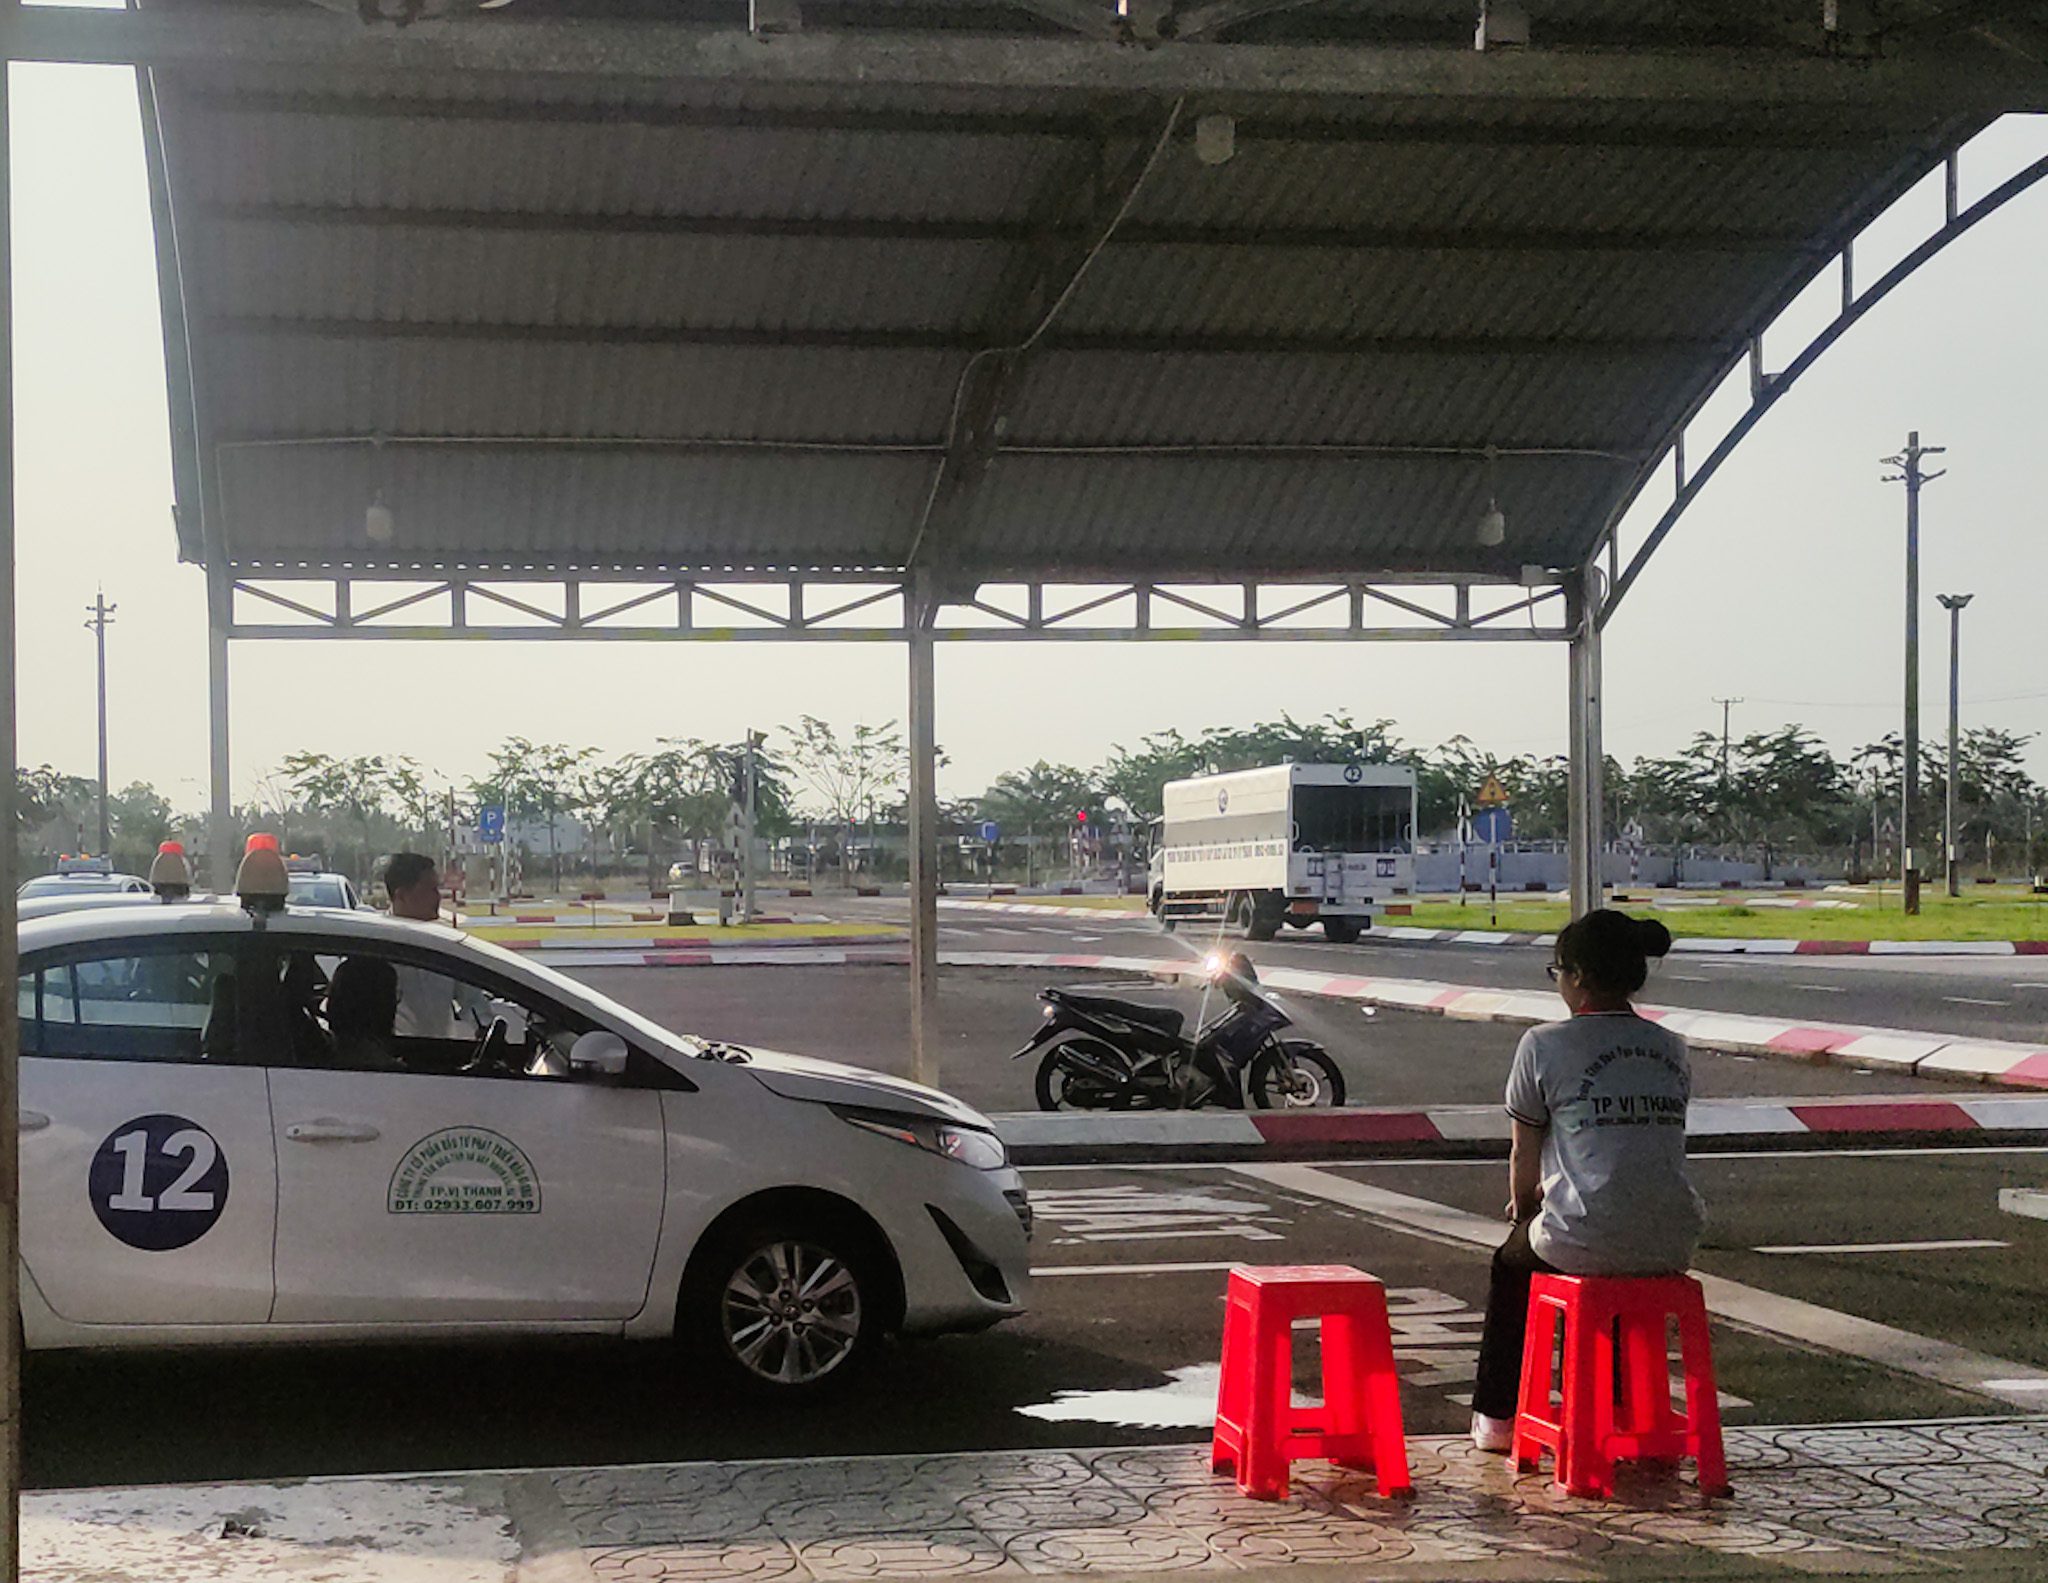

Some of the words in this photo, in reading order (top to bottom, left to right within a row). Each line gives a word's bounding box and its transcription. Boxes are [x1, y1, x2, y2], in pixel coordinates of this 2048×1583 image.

[486, 811, 497, 825] P
[1591, 1096, 1612, 1115] TP
[109, 1129, 217, 1212] 12
[463, 1186, 502, 1196] THANH
